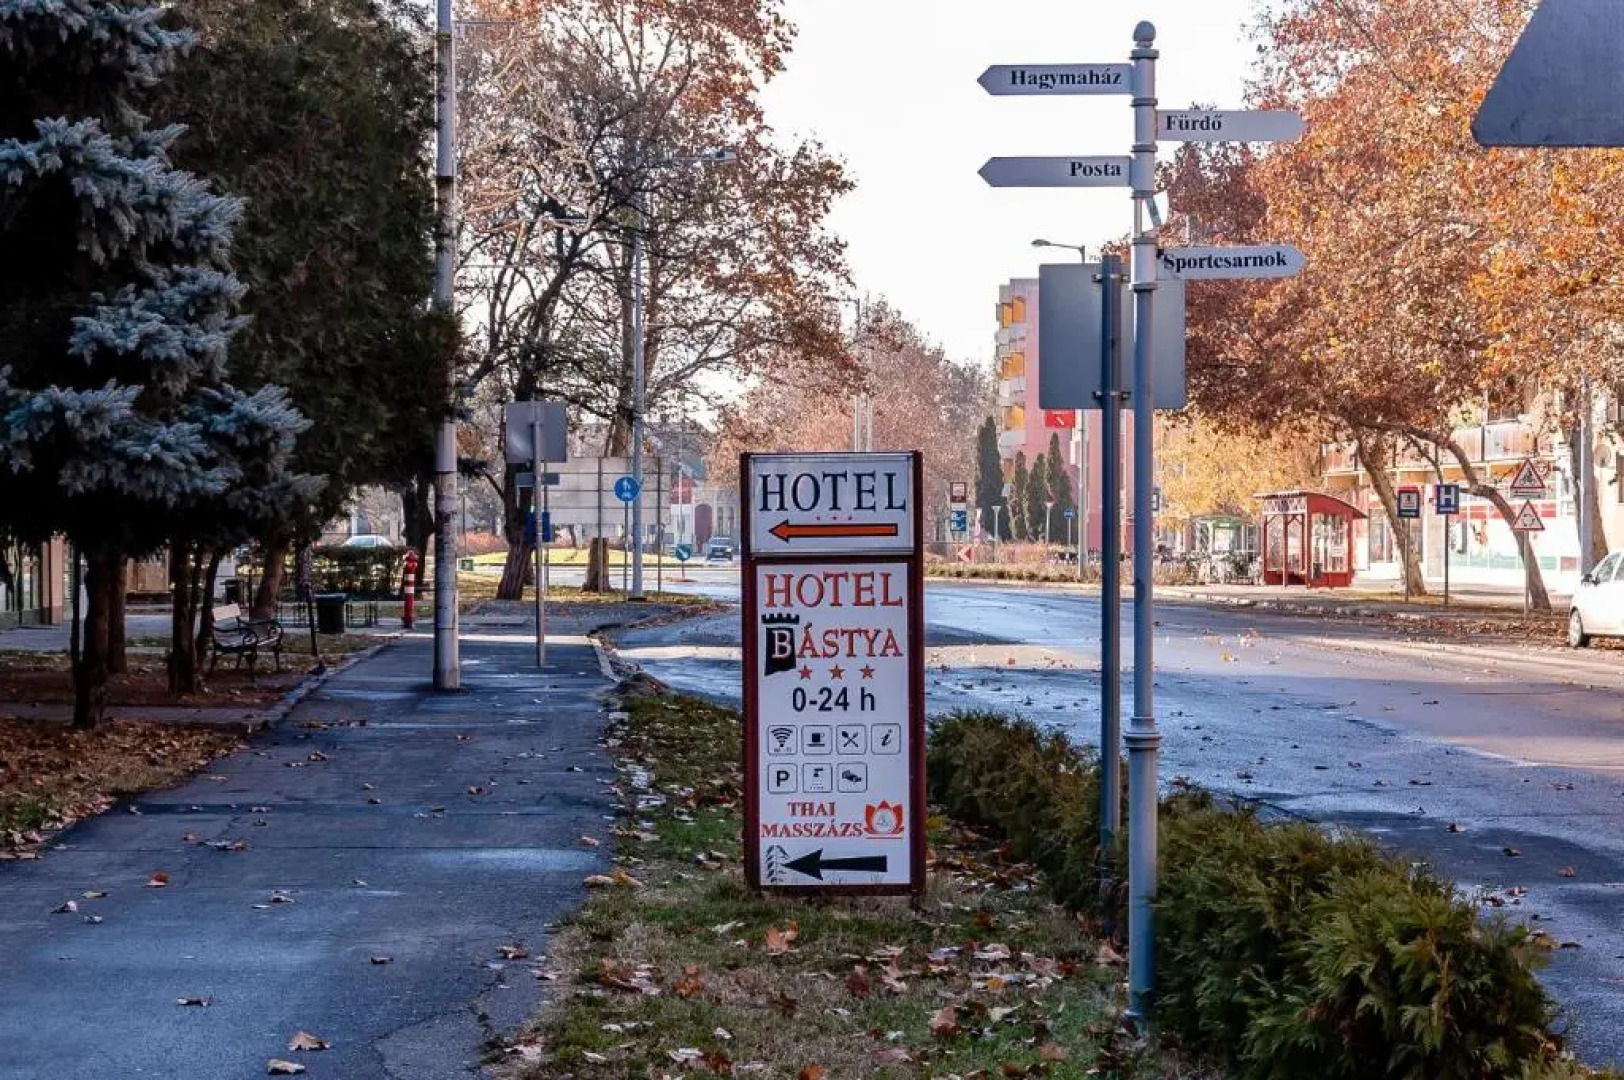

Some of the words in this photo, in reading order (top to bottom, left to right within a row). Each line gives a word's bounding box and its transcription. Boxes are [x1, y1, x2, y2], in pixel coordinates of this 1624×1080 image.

[1010, 68, 1123, 89] Hagymaház
[1166, 114, 1223, 131] Fürdő
[1070, 161, 1122, 178] Posta
[1163, 250, 1288, 273] Sportcsarnok
[758, 470, 906, 512] HOTEL
[764, 571, 903, 608] HOTEL
[771, 622, 903, 659] BÁSTYA
[792, 687, 850, 713] 0-24
[860, 687, 876, 711] h
[776, 770, 790, 788] P
[787, 801, 836, 817] THAI
[761, 819, 864, 838] MASSZÁZS
